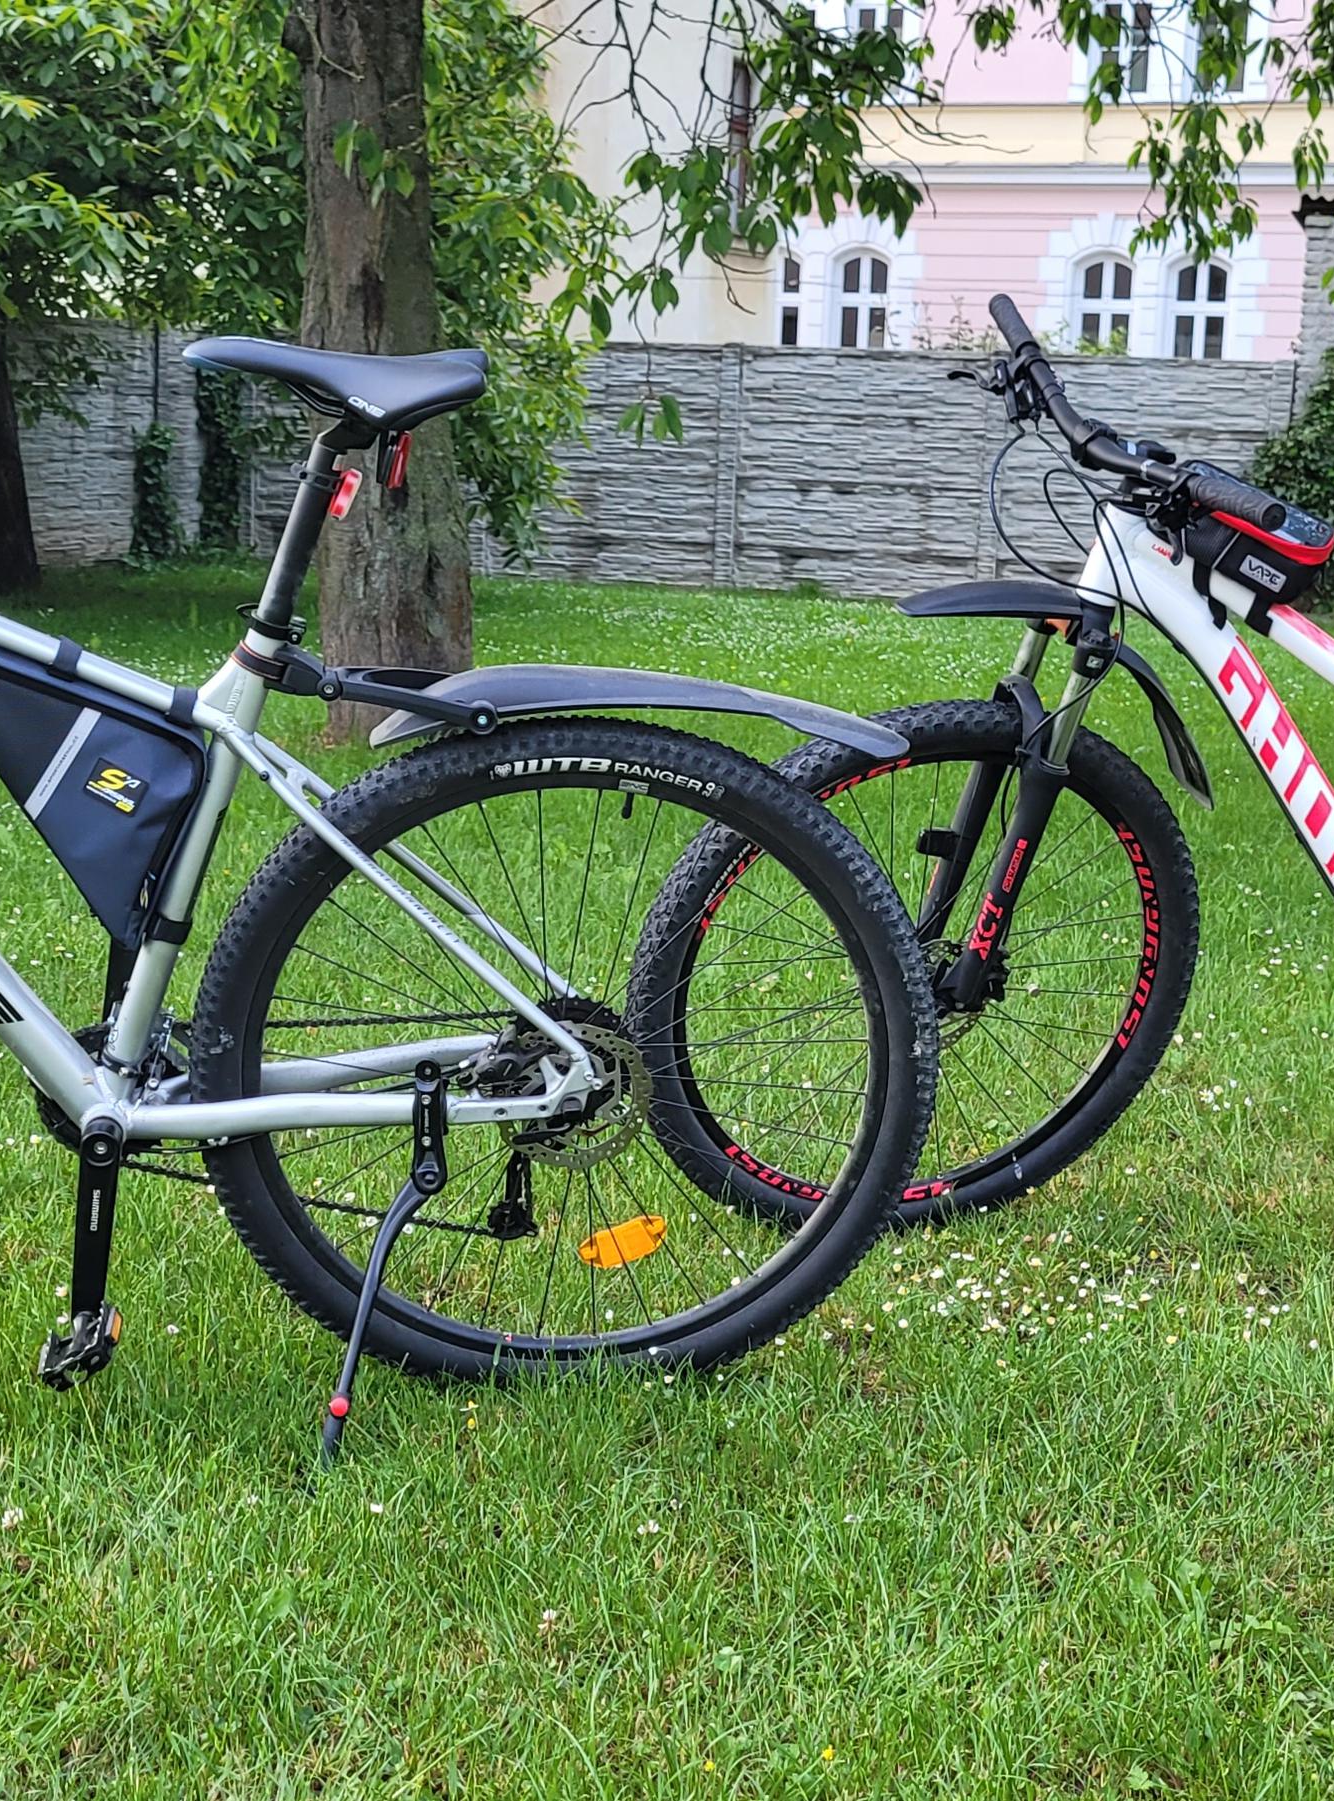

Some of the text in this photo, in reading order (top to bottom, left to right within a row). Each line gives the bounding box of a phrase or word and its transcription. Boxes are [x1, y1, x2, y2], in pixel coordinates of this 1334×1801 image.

[347, 395, 387, 419] ONE
[1247, 558, 1282, 586] VAPE
[512, 756, 613, 776] WTB
[613, 762, 704, 793] RANGER
[968, 891, 1005, 961] XCT
[89, 1188, 102, 1232] SHIMANO
